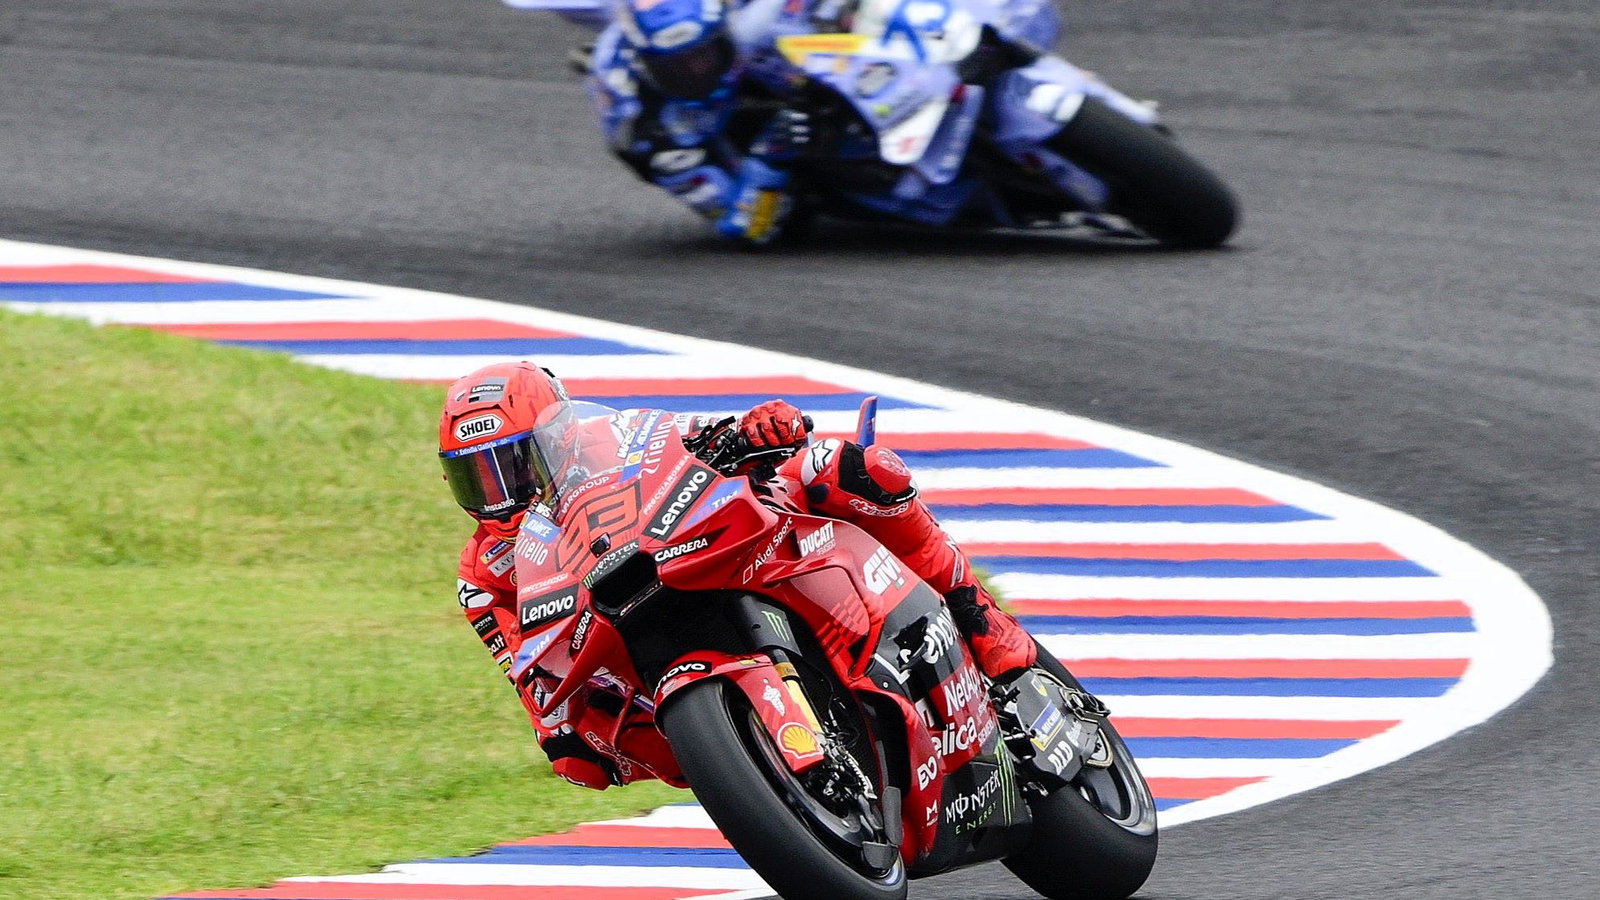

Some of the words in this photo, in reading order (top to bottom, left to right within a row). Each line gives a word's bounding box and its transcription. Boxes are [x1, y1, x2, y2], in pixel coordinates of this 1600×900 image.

[460, 418, 495, 438] SHOEI
[484, 498, 516, 512] Insta360
[650, 470, 708, 536] Lenovo
[654, 537, 709, 562] CARRERA
[755, 542, 774, 571] Audi
[772, 516, 793, 547] Sport
[800, 520, 834, 558] DUCATI
[521, 594, 575, 626] Lenovo
[572, 611, 593, 651] CARRERA
